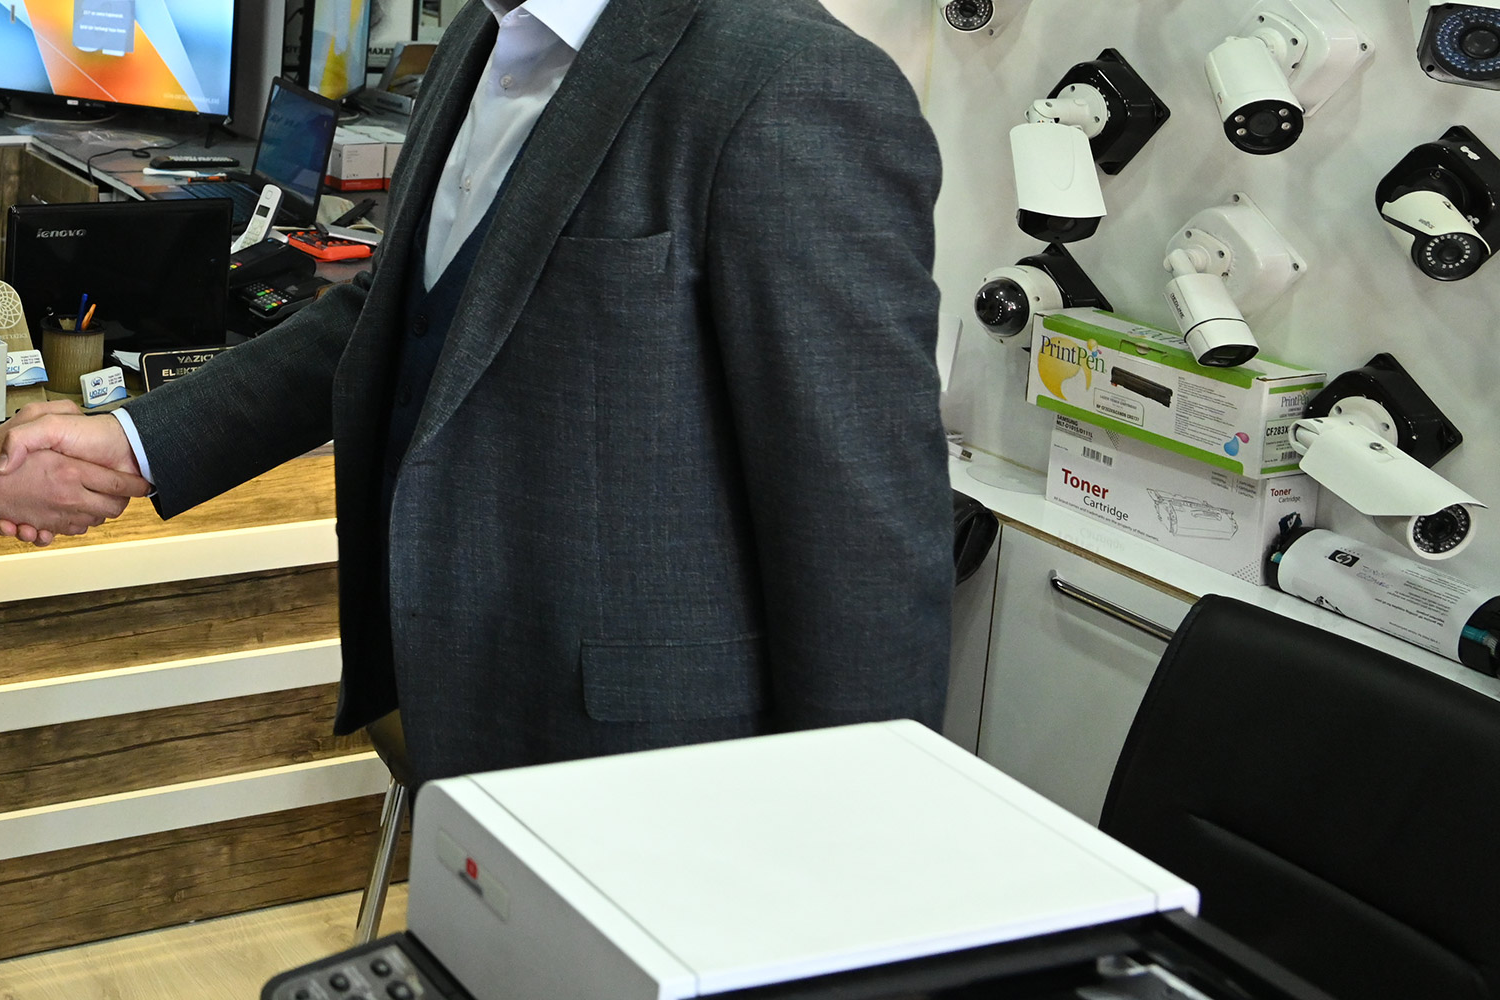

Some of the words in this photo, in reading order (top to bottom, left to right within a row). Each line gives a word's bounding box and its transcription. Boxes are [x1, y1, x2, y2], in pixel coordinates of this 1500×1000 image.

[36, 228, 86, 238] lenovo
[177, 354, 214, 364] YAZICI
[1041, 335, 1106, 374] PrintPen
[162, 367, 200, 377] ELEKT
[1057, 414, 1079, 426] SAMSUNG
[1266, 425, 1288, 438] CF283X
[1062, 468, 1109, 499] Toner
[1270, 488, 1291, 498] Toner
[1278, 495, 1301, 504] Cartridge
[1083, 496, 1129, 521] Cartridge
